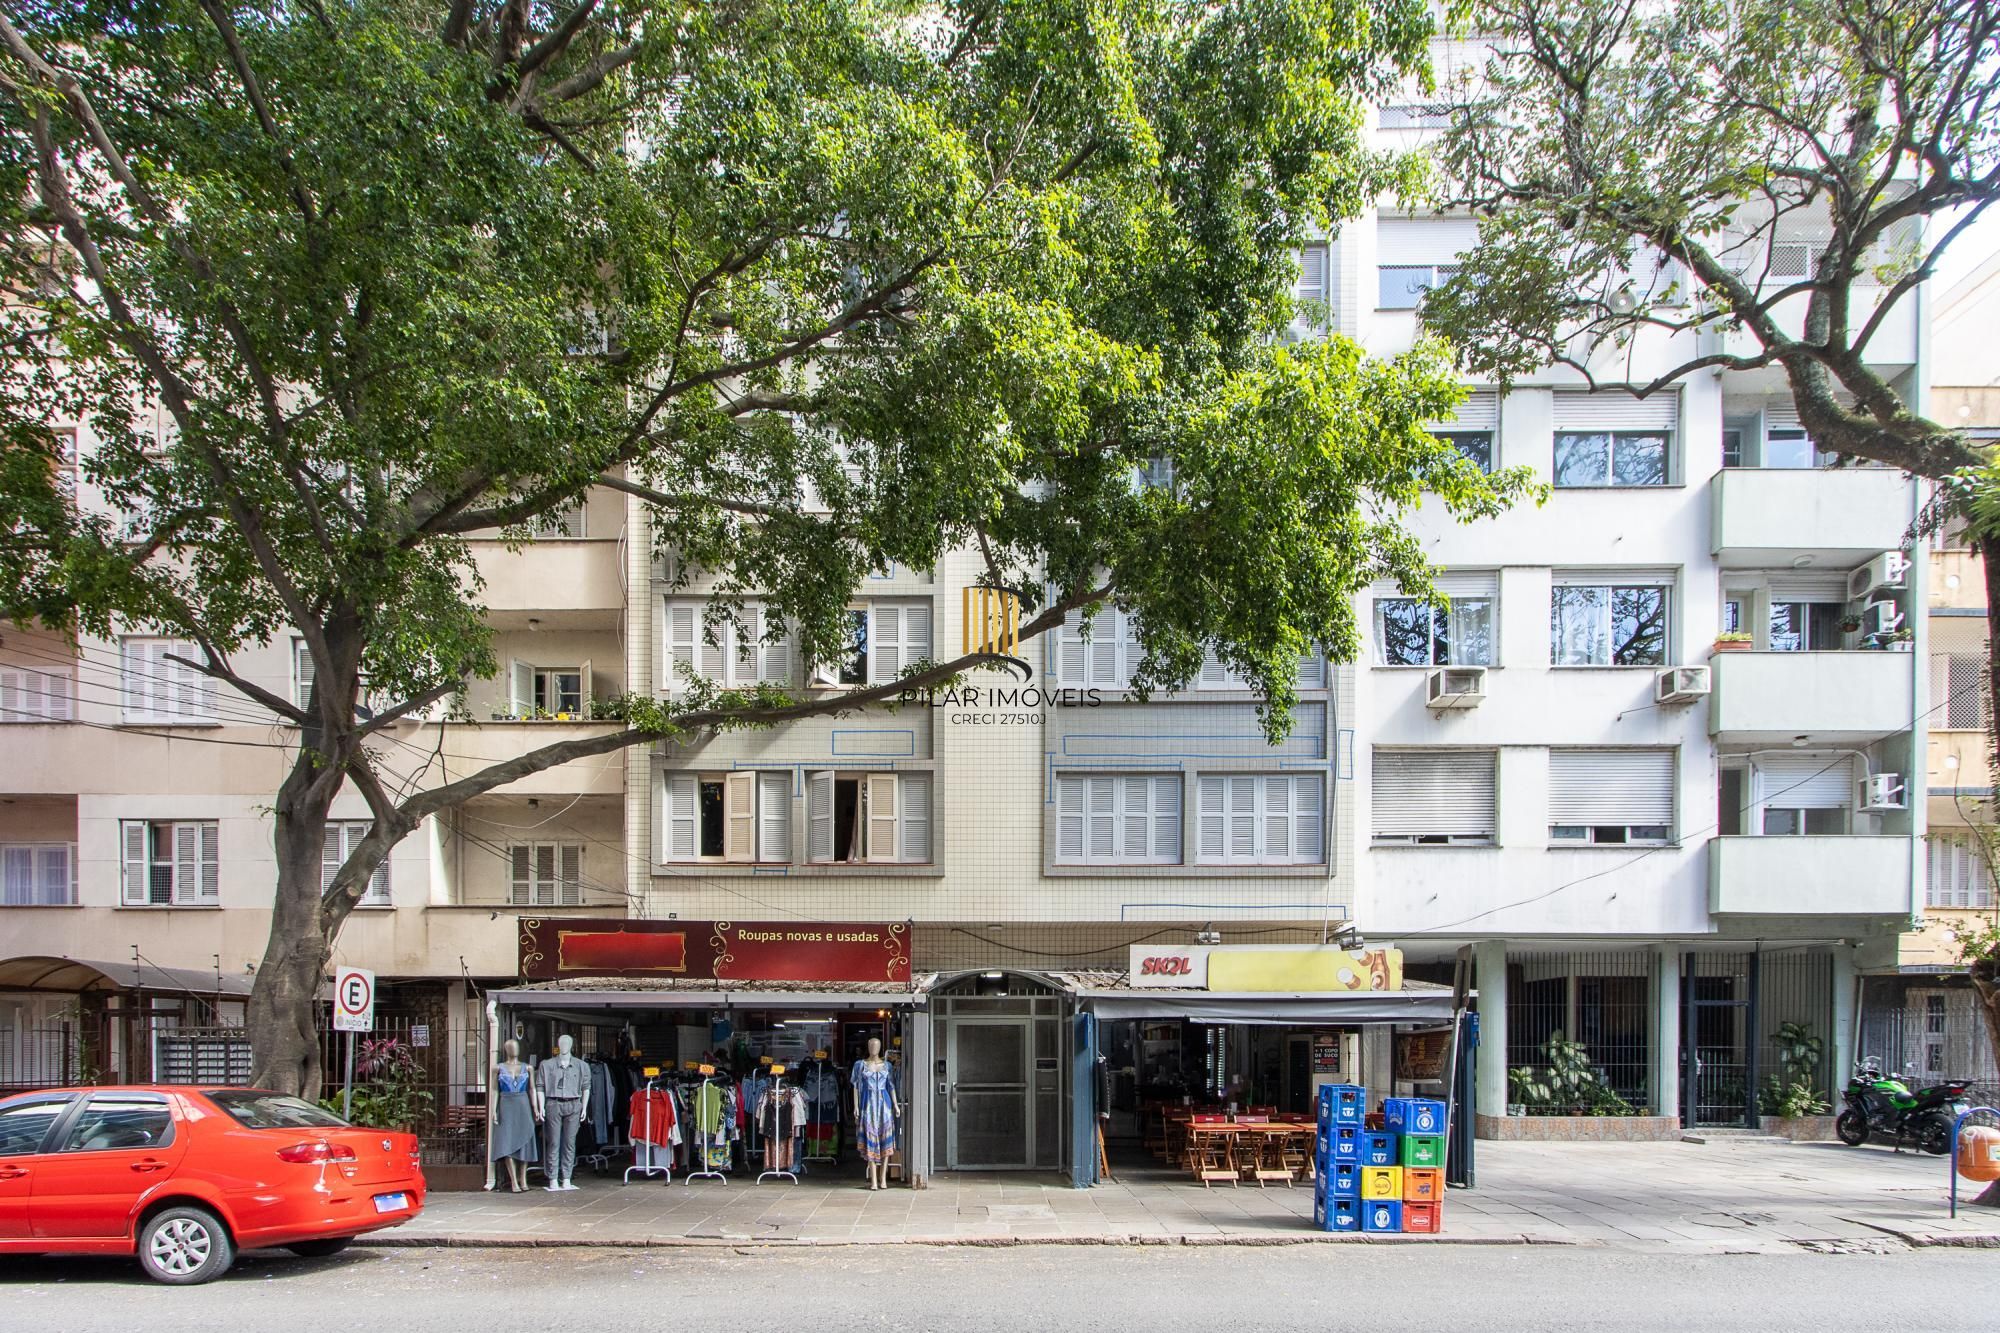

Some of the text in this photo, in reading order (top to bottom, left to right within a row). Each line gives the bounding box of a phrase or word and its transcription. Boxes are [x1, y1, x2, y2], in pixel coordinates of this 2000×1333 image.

[738, 929, 879, 943] Roupas novas e usadas
[1140, 956, 1193, 976] SKOL
[349, 982, 360, 1006] E
